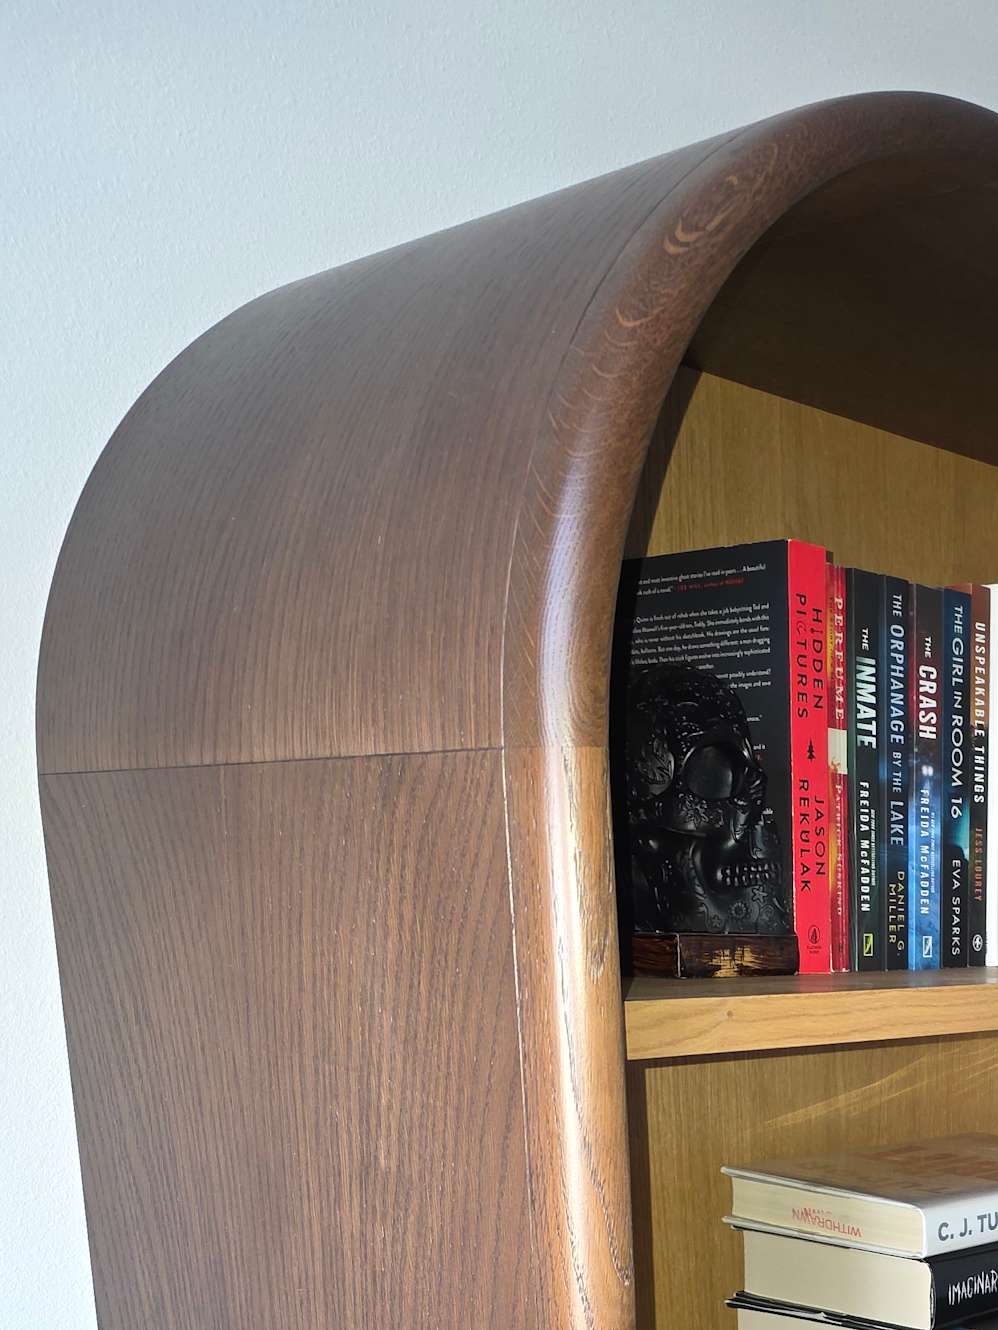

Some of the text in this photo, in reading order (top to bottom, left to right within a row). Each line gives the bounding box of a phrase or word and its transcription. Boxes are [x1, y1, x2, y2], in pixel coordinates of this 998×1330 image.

[796, 592, 808, 718] PICTURES
[811, 607, 823, 709] HIDDEN
[834, 595, 844, 720] PERFUME
[856, 655, 877, 749] INMATE
[919, 665, 937, 740] CRASH
[890, 594, 904, 846] THE ORPHANAGE BY THE LAKE
[951, 605, 963, 819] THE GIRL IN ROOM 16
[974, 622, 986, 803] UNSPEAKABLE THINGS
[799, 779, 811, 892] REKULAK
[815, 796, 826, 875] JASON
[860, 781, 870, 912] FREIDA McFADDEN
[920, 789, 929, 915] FREIDA McFADDEN
[974, 828, 983, 902] JESS LOUREY
[889, 883, 897, 943] MILLER
[896, 871, 904, 932] DANIEL
[951, 859, 960, 956] EVA SPARKS
[792, 1207, 862, 1237] WITHDRAWN
[938, 1222, 954, 1241] C.
[959, 1218, 972, 1238] J.
